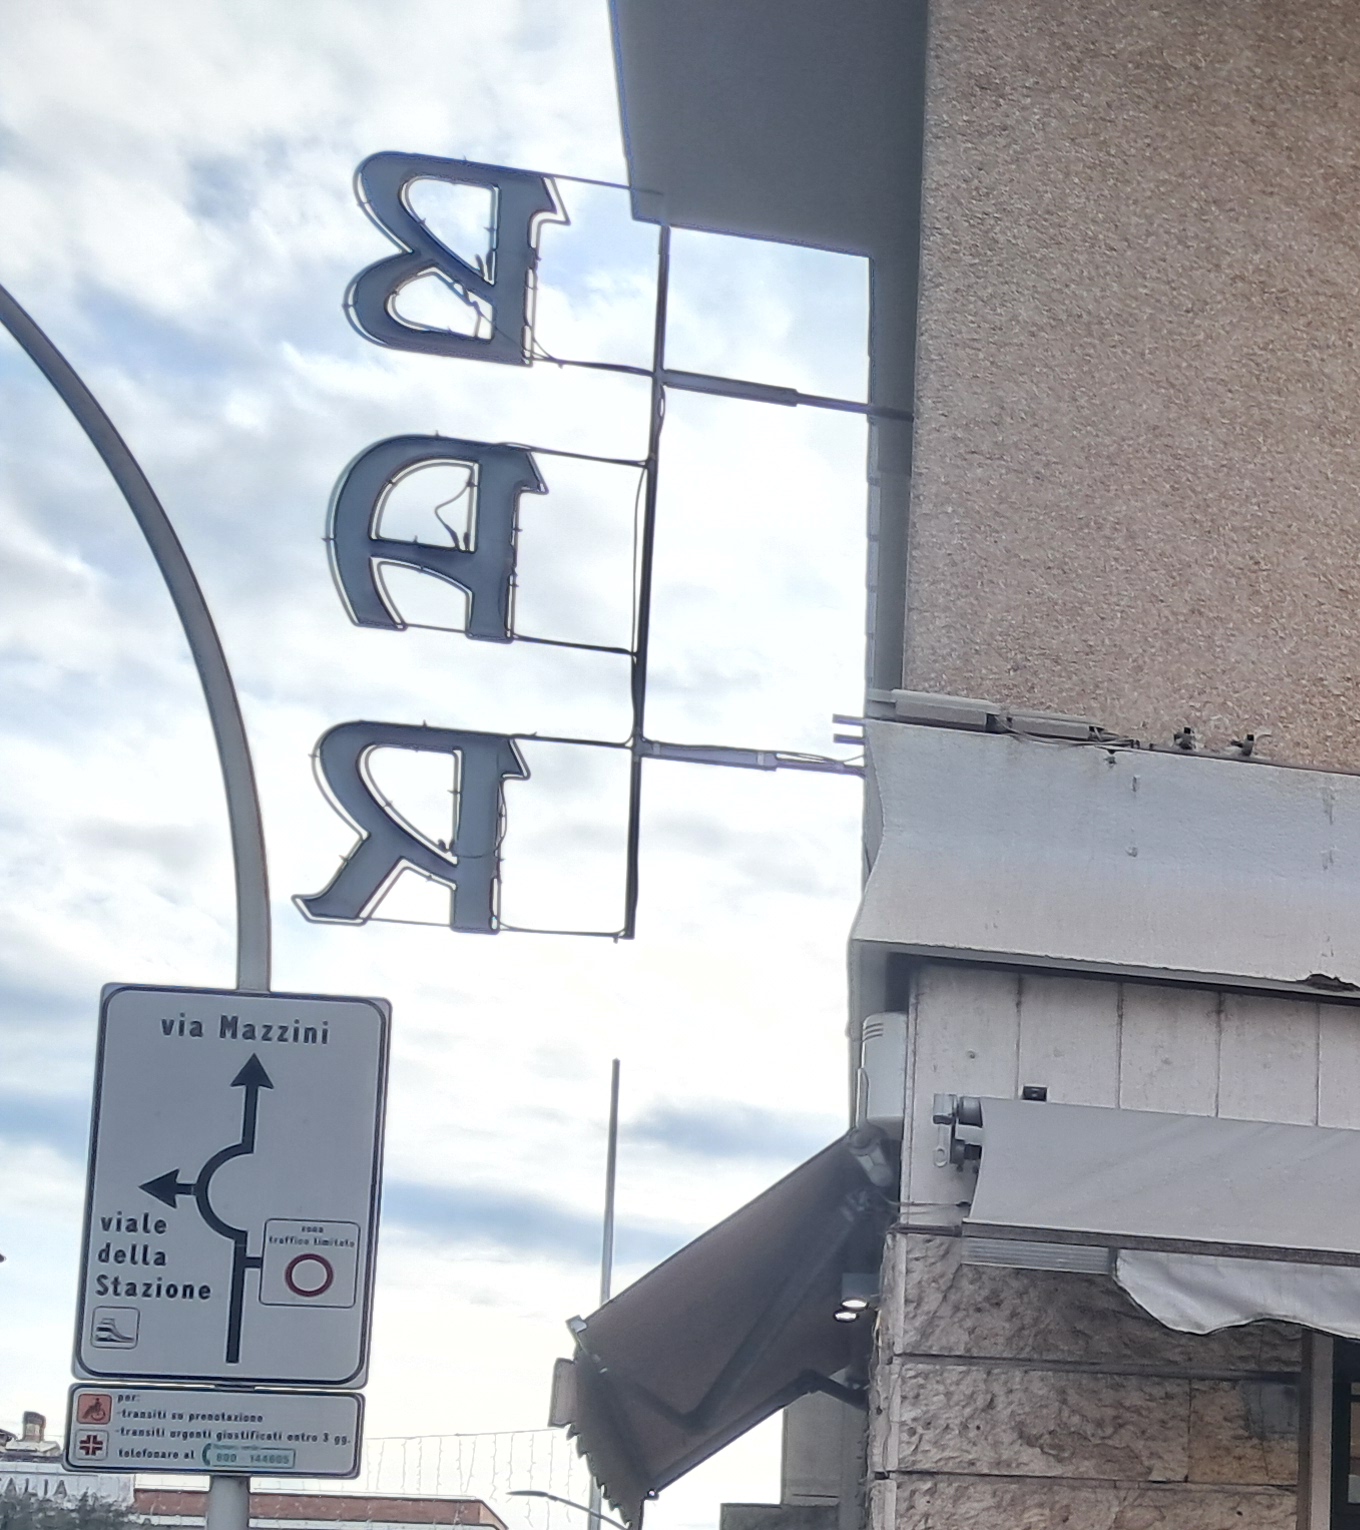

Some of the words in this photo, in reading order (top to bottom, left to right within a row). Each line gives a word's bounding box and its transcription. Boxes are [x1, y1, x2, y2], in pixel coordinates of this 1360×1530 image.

[160, 1014, 204, 1038] via
[219, 1015, 331, 1046] Mazzini
[99, 1211, 168, 1236] viale
[97, 1243, 167, 1268] della
[95, 1275, 212, 1301] Stazione
[188, 1412, 263, 1423] prenotazione
[169, 1430, 212, 1442] urgenti
[216, 1430, 283, 1442] giustificati
[287, 1433, 318, 1443] entro
[117, 1448, 179, 1460] telefonare
[184, 1449, 195, 1460] al
[0, 1477, 68, 1501] ALIA
